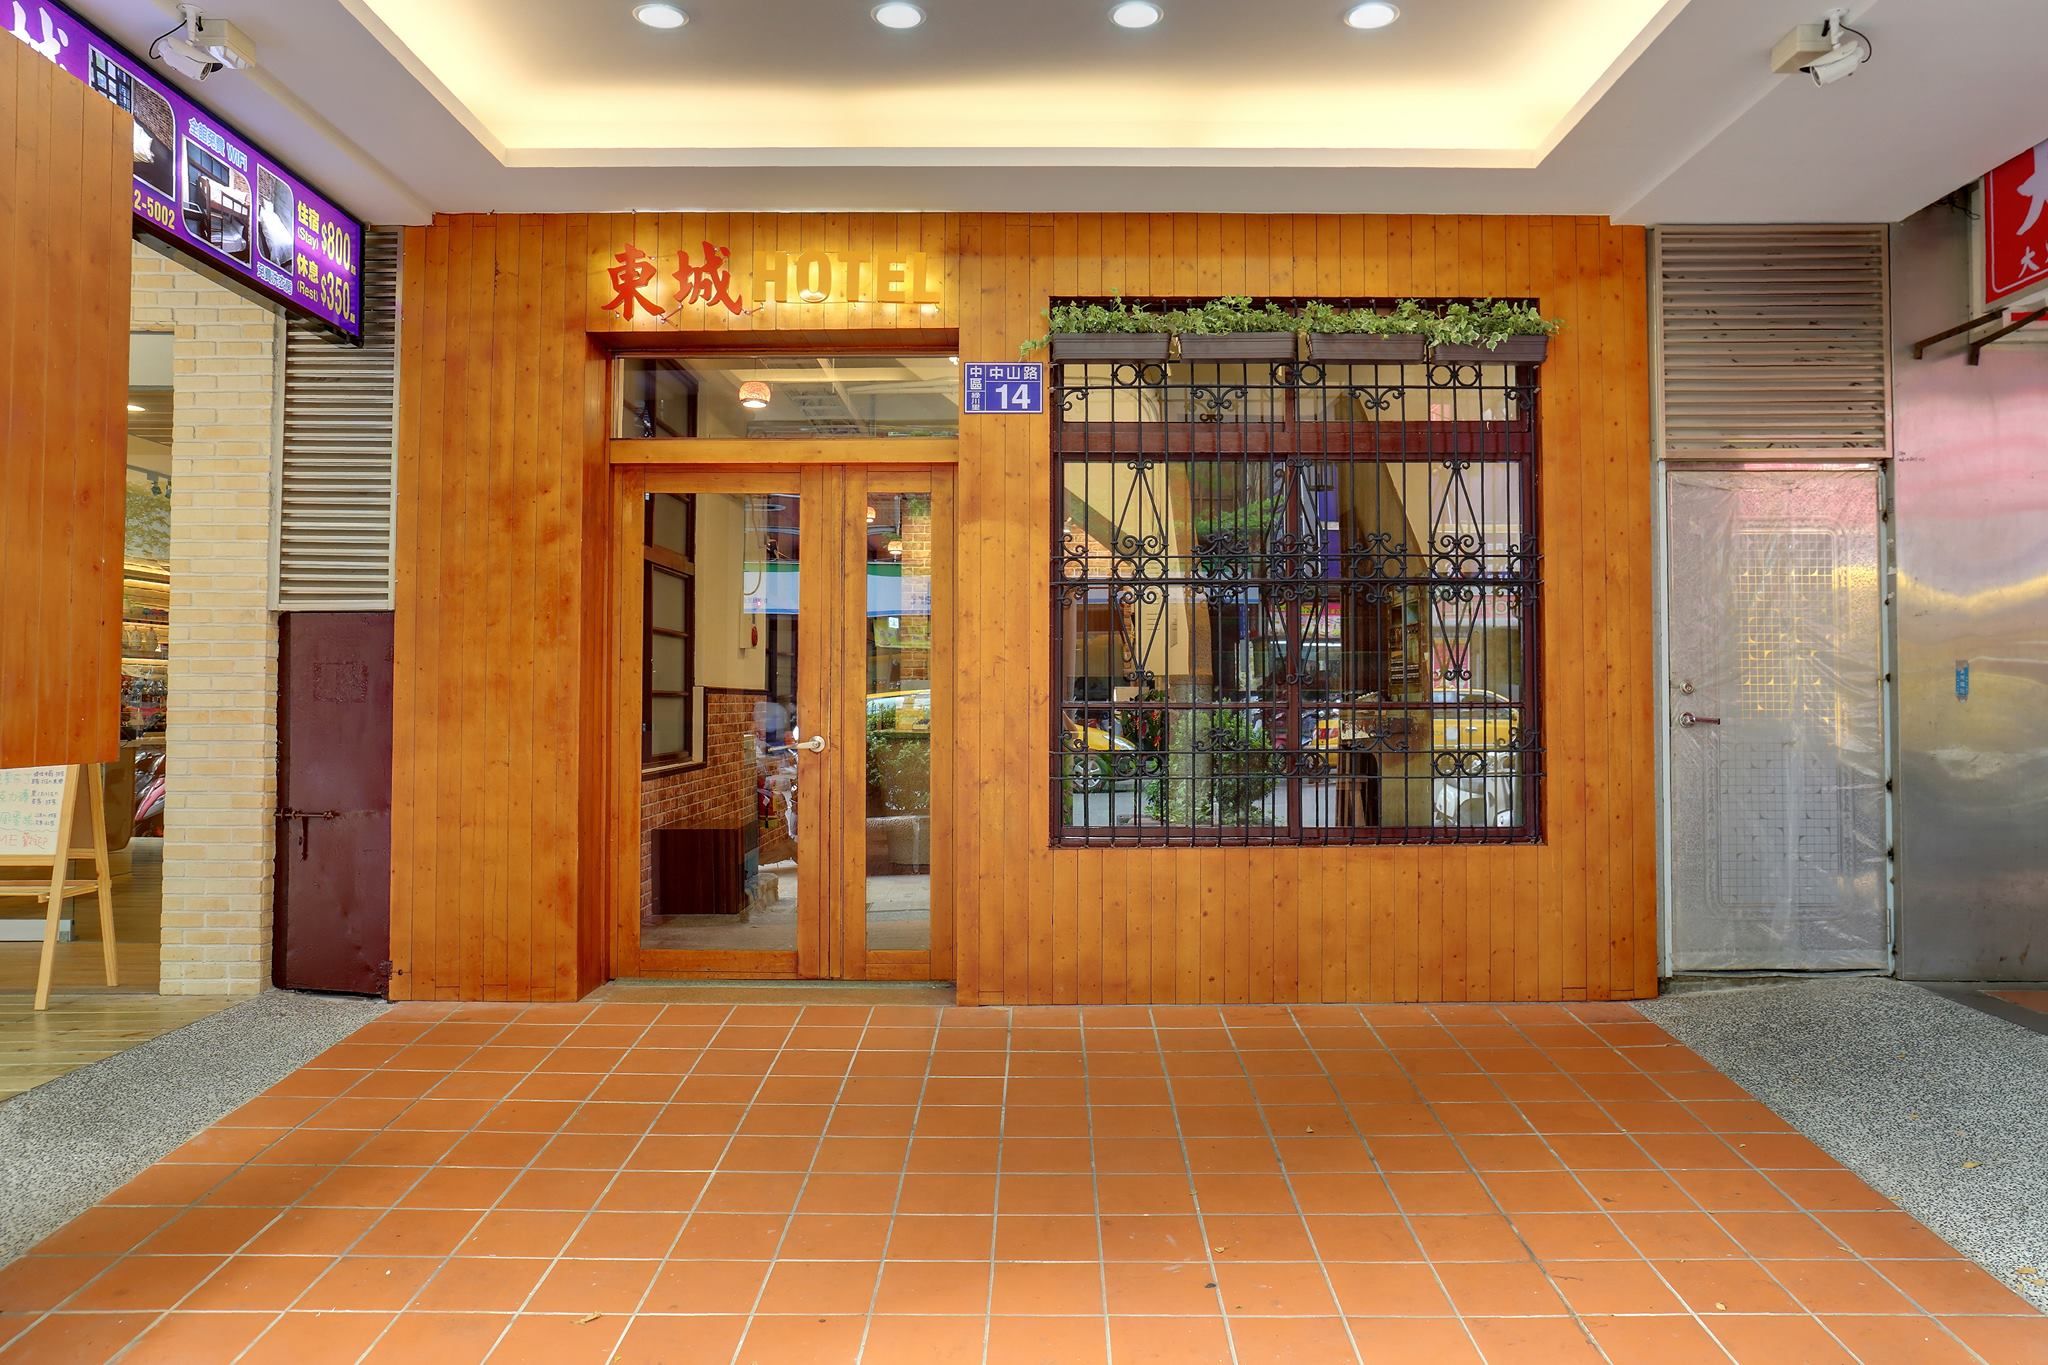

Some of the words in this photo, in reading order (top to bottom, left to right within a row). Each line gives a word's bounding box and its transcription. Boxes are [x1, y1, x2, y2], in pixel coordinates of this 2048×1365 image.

[297, 200, 320, 235] 住宿
[321, 221, 351, 271] $800
[297, 226, 319, 250] (Stay)
[296, 252, 320, 284] 休息
[320, 271, 351, 320] $350
[296, 280, 319, 302] (Rest)
[601, 240, 743, 321] 東城
[753, 249, 941, 303] HOTEL
[970, 366, 982, 389] 中區
[989, 366, 1037, 379] 中山路
[995, 384, 1030, 408] 14
